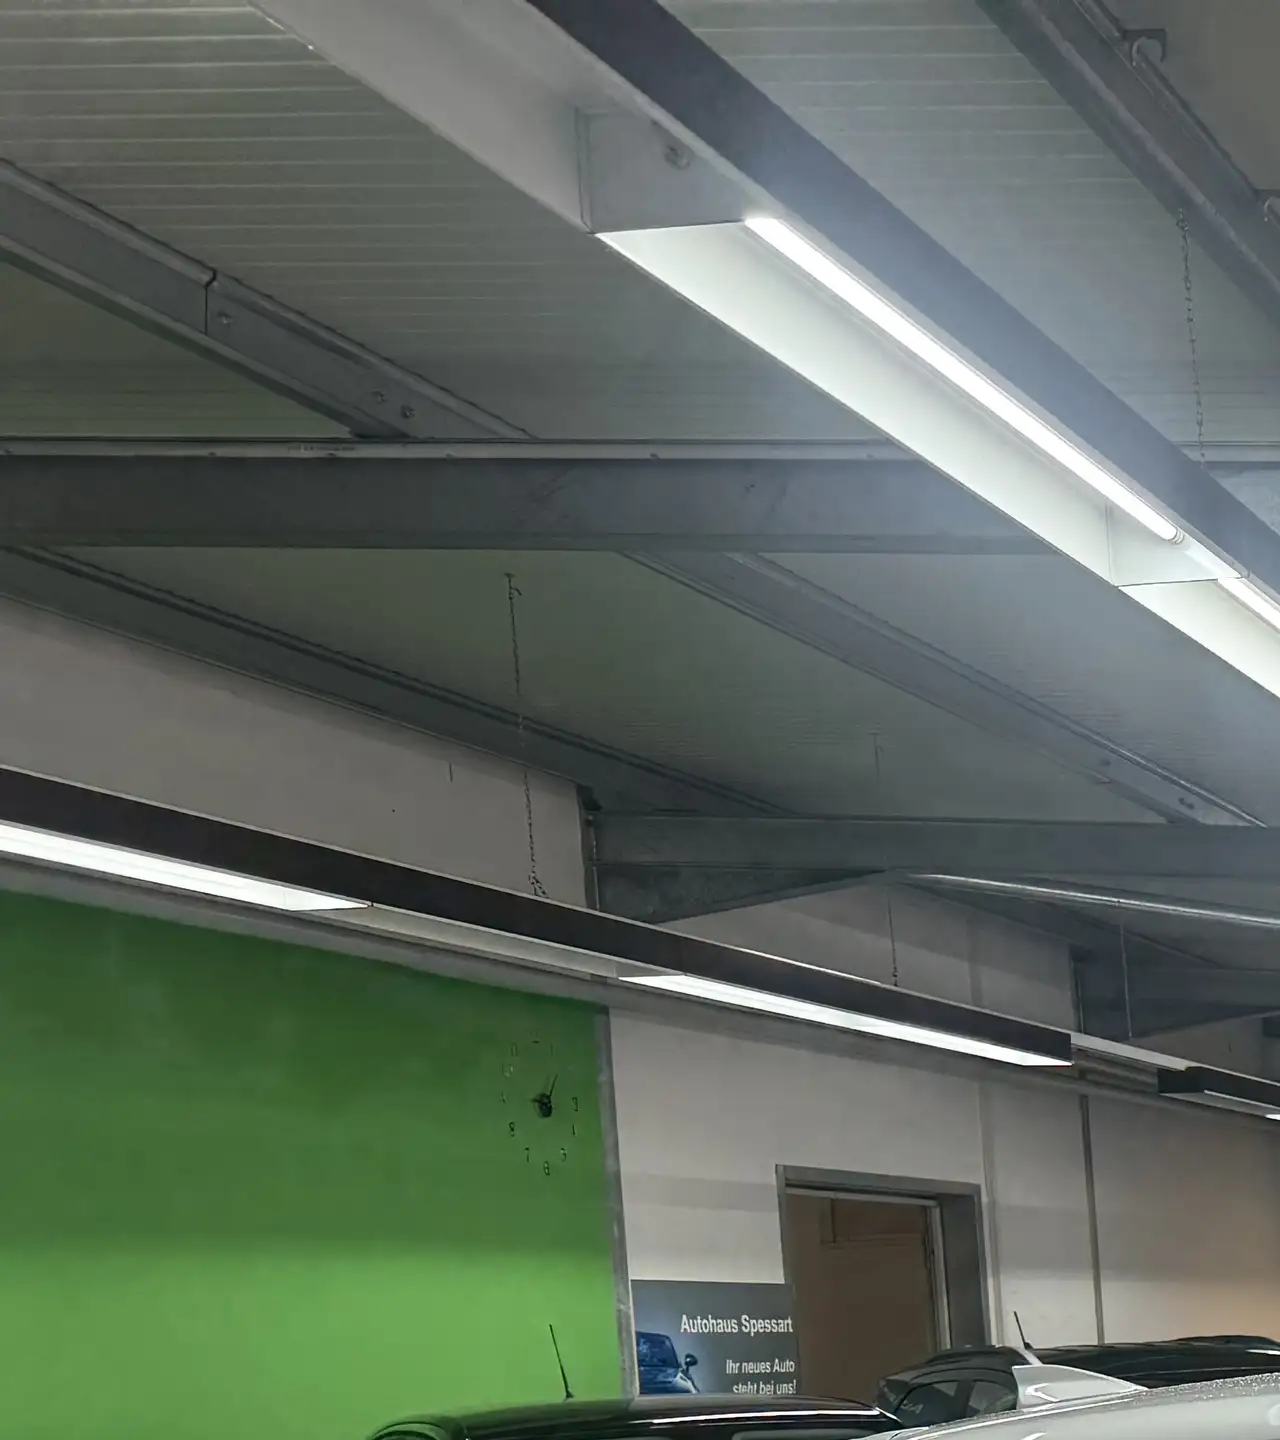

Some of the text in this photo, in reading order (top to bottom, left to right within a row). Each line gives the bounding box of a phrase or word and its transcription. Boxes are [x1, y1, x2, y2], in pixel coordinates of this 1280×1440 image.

[680, 1313, 794, 1337] Autohaus Spessart
[725, 1357, 795, 1374] Ihr neues Auto
[732, 1379, 797, 1395] steht bei uns!
